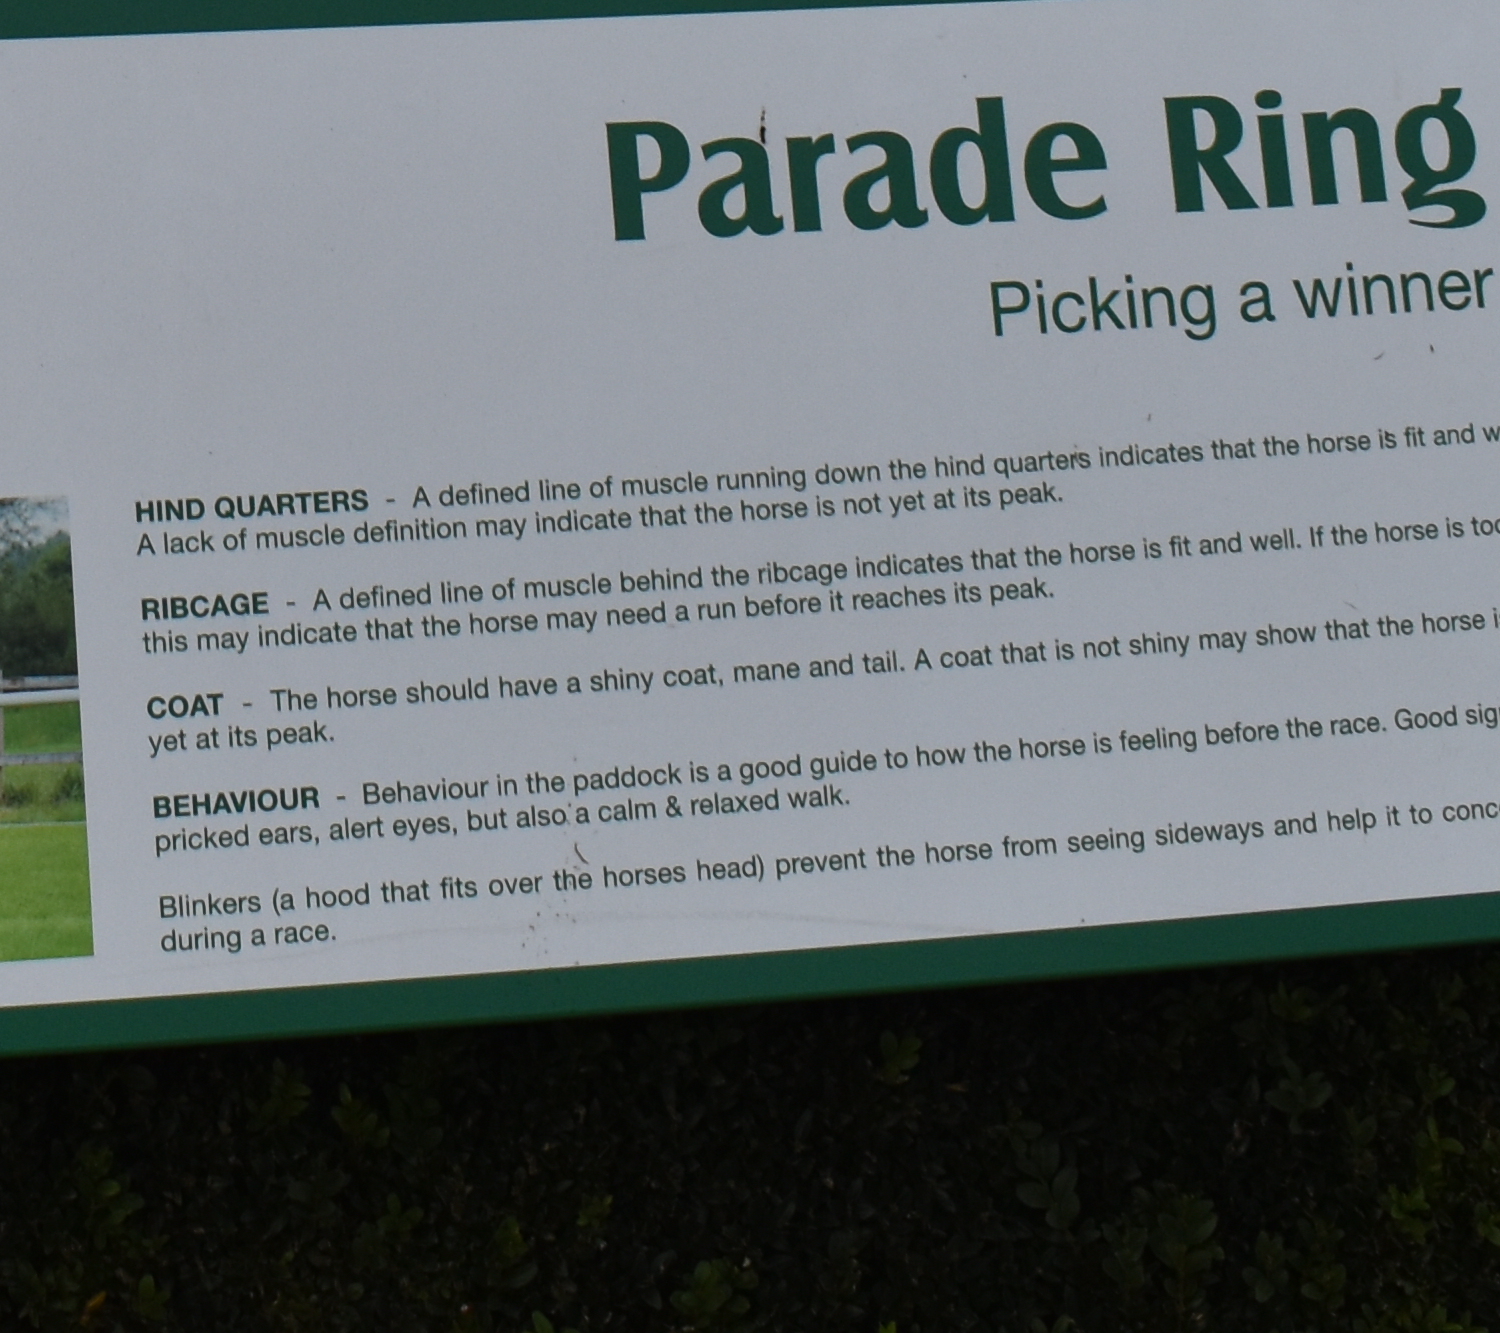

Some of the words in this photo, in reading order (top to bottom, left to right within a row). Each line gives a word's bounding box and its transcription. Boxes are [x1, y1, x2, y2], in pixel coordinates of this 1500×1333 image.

[604, 95, 1109, 243] Parade
[1162, 86, 1488, 230] Ring
[989, 273, 1218, 342] Picking
[1238, 280, 1277, 324] a
[1291, 261, 1495, 320] winner
[134, 497, 206, 524] HIND
[213, 488, 370, 521] QUARTERS
[411, 485, 432, 509] A
[438, 479, 531, 508] defined
[538, 478, 582, 503] line
[588, 474, 614, 500] of
[621, 470, 709, 498] muscle
[716, 465, 807, 493] running
[814, 462, 882, 486] down
[887, 458, 927, 482] the
[933, 452, 986, 479] hind
[992, 444, 1092, 480] quarters
[1098, 442, 1205, 468] indicates
[1209, 437, 1258, 461] that
[1261, 435, 1301, 458] the
[1306, 432, 1372, 455] horse
[1377, 428, 1398, 450] is
[1402, 425, 1427, 448] fit
[1432, 422, 1476, 447] and
[136, 532, 157, 557] A
[162, 529, 216, 556] lack
[222, 526, 248, 552] of
[255, 522, 346, 551] muscle
[352, 516, 468, 545] definition
[475, 517, 528, 542] may
[534, 508, 633, 535] indicate
[637, 503, 688, 528] that
[693, 500, 734, 525] the
[739, 498, 809, 523] horse
[815, 494, 836, 518] is
[842, 492, 883, 516] not
[887, 489, 927, 519] yet
[933, 487, 957, 511] at
[962, 485, 992, 509] its
[998, 480, 1064, 511] peak.
[140, 590, 270, 622] RIBCAGE
[312, 587, 333, 613] A
[338, 581, 432, 611] defined
[440, 580, 484, 605] line
[491, 576, 516, 602] of
[523, 572, 613, 600] muscle
[619, 565, 704, 594] behind
[709, 563, 750, 588] the
[757, 560, 848, 587] ribcage
[854, 552, 965, 579] indicates
[969, 547, 1019, 572] that
[1023, 544, 1063, 568] the
[1068, 541, 1136, 565] horse
[1142, 537, 1163, 560] is
[1168, 534, 1193, 558] fit
[1198, 530, 1243, 557] and
[1248, 527, 1302, 553] well.
[1309, 524, 1325, 549] If
[1329, 523, 1369, 547] the
[1373, 521, 1440, 544] horse
[1444, 516, 1466, 539] is
[152, 785, 321, 820] BEHAVIOUR
[362, 776, 490, 806] Behaviour
[495, 773, 519, 797] in
[524, 770, 566, 795] the
[572, 762, 683, 798] paddock
[688, 760, 710, 784] is
[716, 763, 733, 783] a
[738, 753, 803, 787] good
[809, 748, 878, 782] guide
[883, 747, 909, 770] to
[915, 744, 967, 768] how
[972, 739, 1013, 764] the
[1018, 737, 1087, 761] horse
[1092, 731, 1114, 755] is
[1118, 726, 1198, 754] feeling
[1203, 720, 1280, 746] before
[1284, 716, 1324, 740] the
[1329, 715, 1388, 736] race.
[1393, 704, 1459, 732] Good
[158, 892, 262, 920] Blinkers
[272, 887, 296, 918] (a
[305, 881, 371, 910] hood
[379, 878, 431, 905] that
[438, 875, 479, 900] fits
[488, 875, 544, 897] over
[551, 868, 594, 892] the
[602, 865, 687, 889] horses
[695, 853, 765, 883] head)
[775, 847, 868, 882] prevent
[875, 844, 916, 868] the
[924, 841, 994, 865] horse
[1001, 834, 1058, 859] from
[1066, 827, 1146, 855] seeing
[1154, 820, 1265, 847] sideways
[1273, 810, 1318, 837] and
[1326, 807, 1378, 836] help
[1385, 805, 1402, 828] it
[1408, 804, 1434, 826] to
[160, 925, 242, 955] during
[250, 927, 267, 948] a
[273, 923, 337, 946] race.
